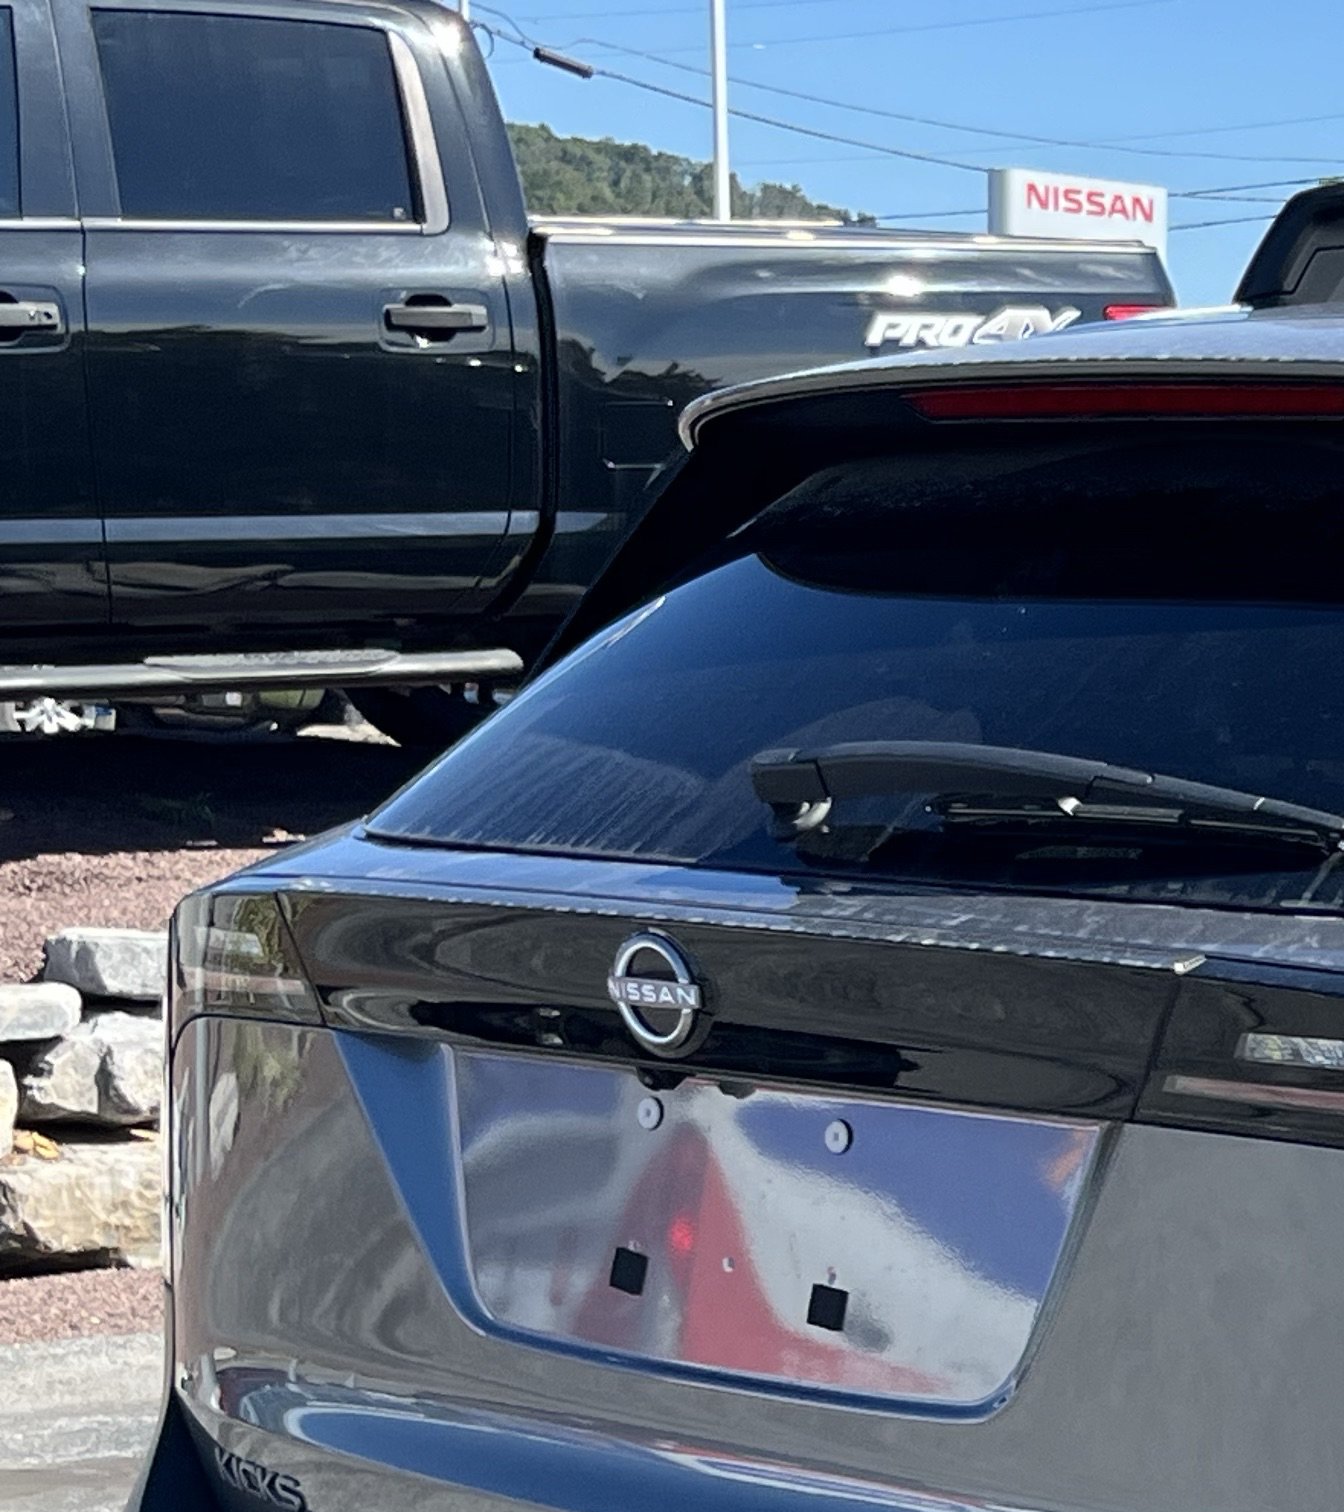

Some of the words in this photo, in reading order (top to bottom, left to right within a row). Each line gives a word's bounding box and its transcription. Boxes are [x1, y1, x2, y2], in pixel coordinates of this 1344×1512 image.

[1026, 182, 1154, 223] NISSAN
[608, 979, 697, 1006] NISSAN
[215, 1447, 306, 1512] KICKS
